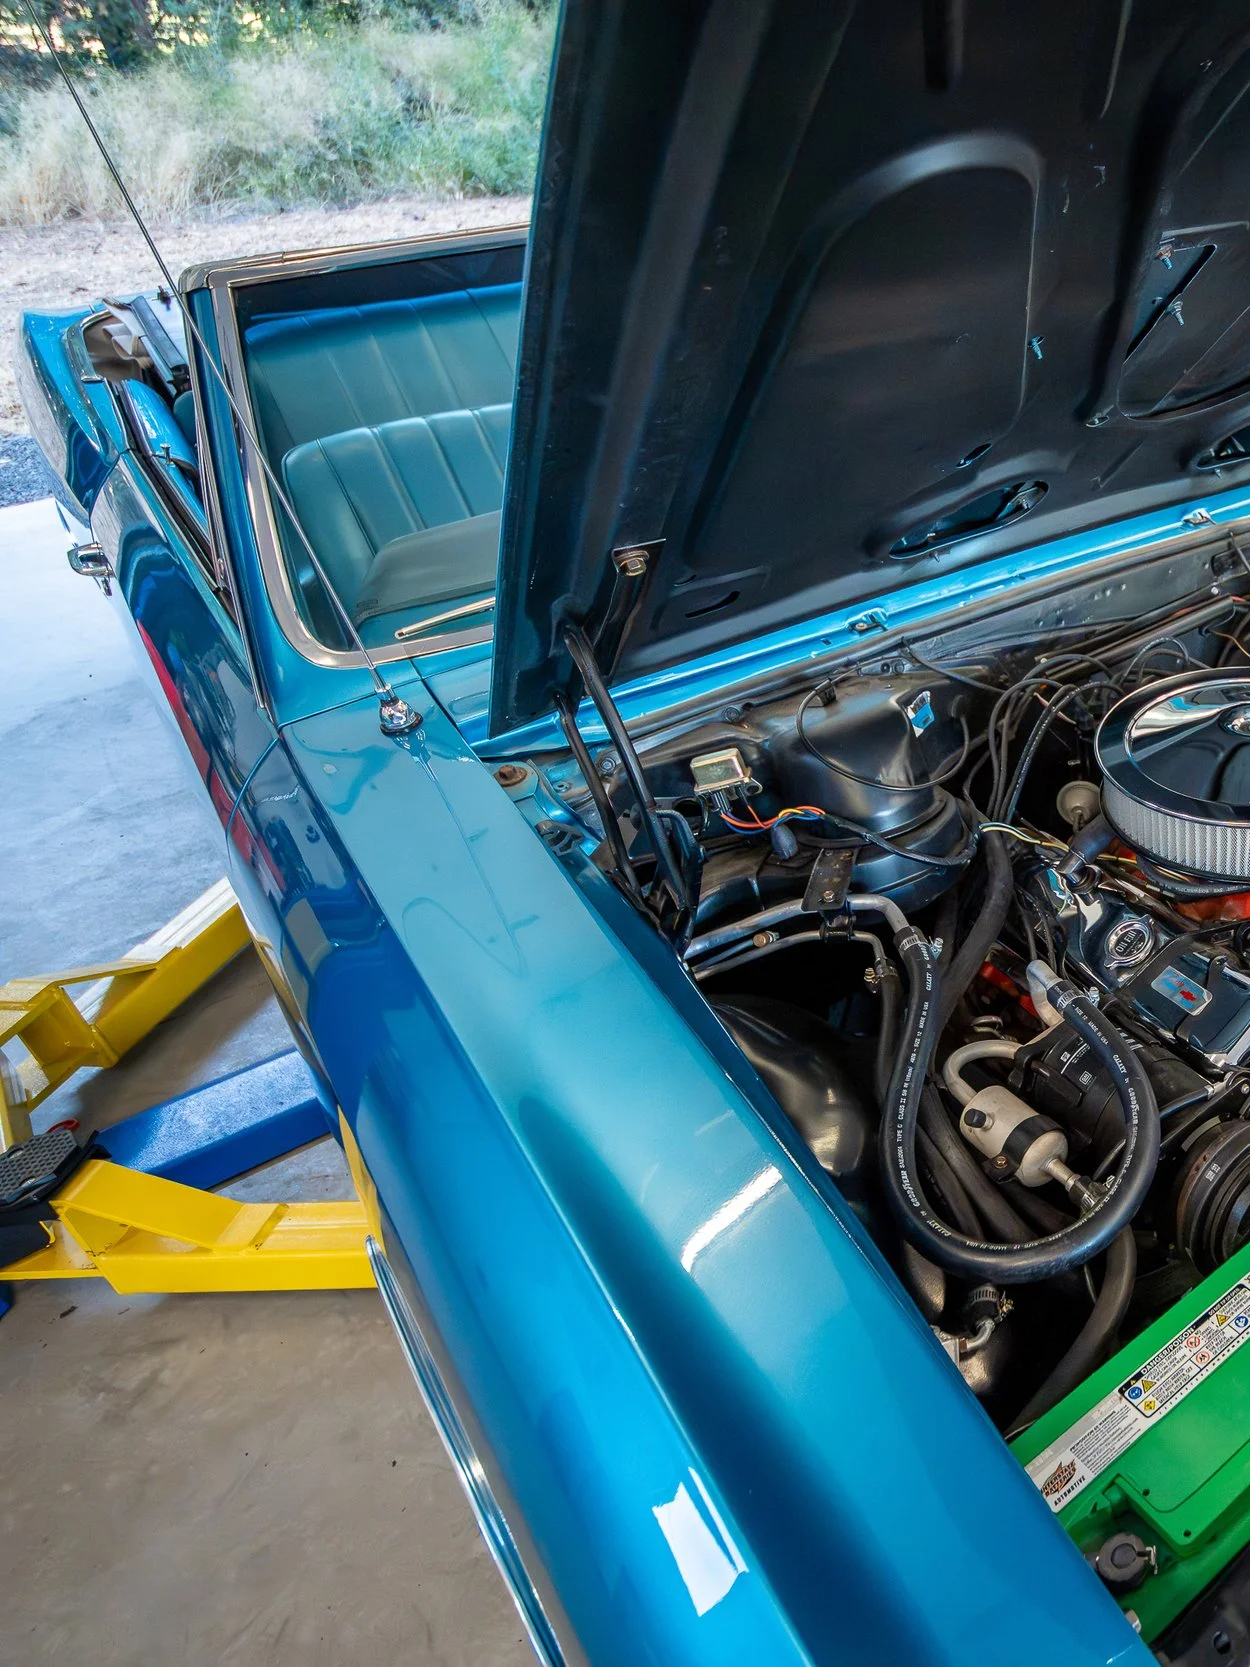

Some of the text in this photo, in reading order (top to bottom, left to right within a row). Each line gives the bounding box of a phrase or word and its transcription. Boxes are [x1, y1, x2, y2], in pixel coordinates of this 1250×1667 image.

[1088, 1021, 1098, 1032] MADE
[1113, 1055, 1127, 1073] GALAXY
[1128, 1088, 1139, 1124] GOODYEAR
[901, 1171, 920, 1206] GOODYEAR
[1139, 1326, 1195, 1375] DANGER/POISON
[1052, 1474, 1086, 1506] AUTOMOTIVE
